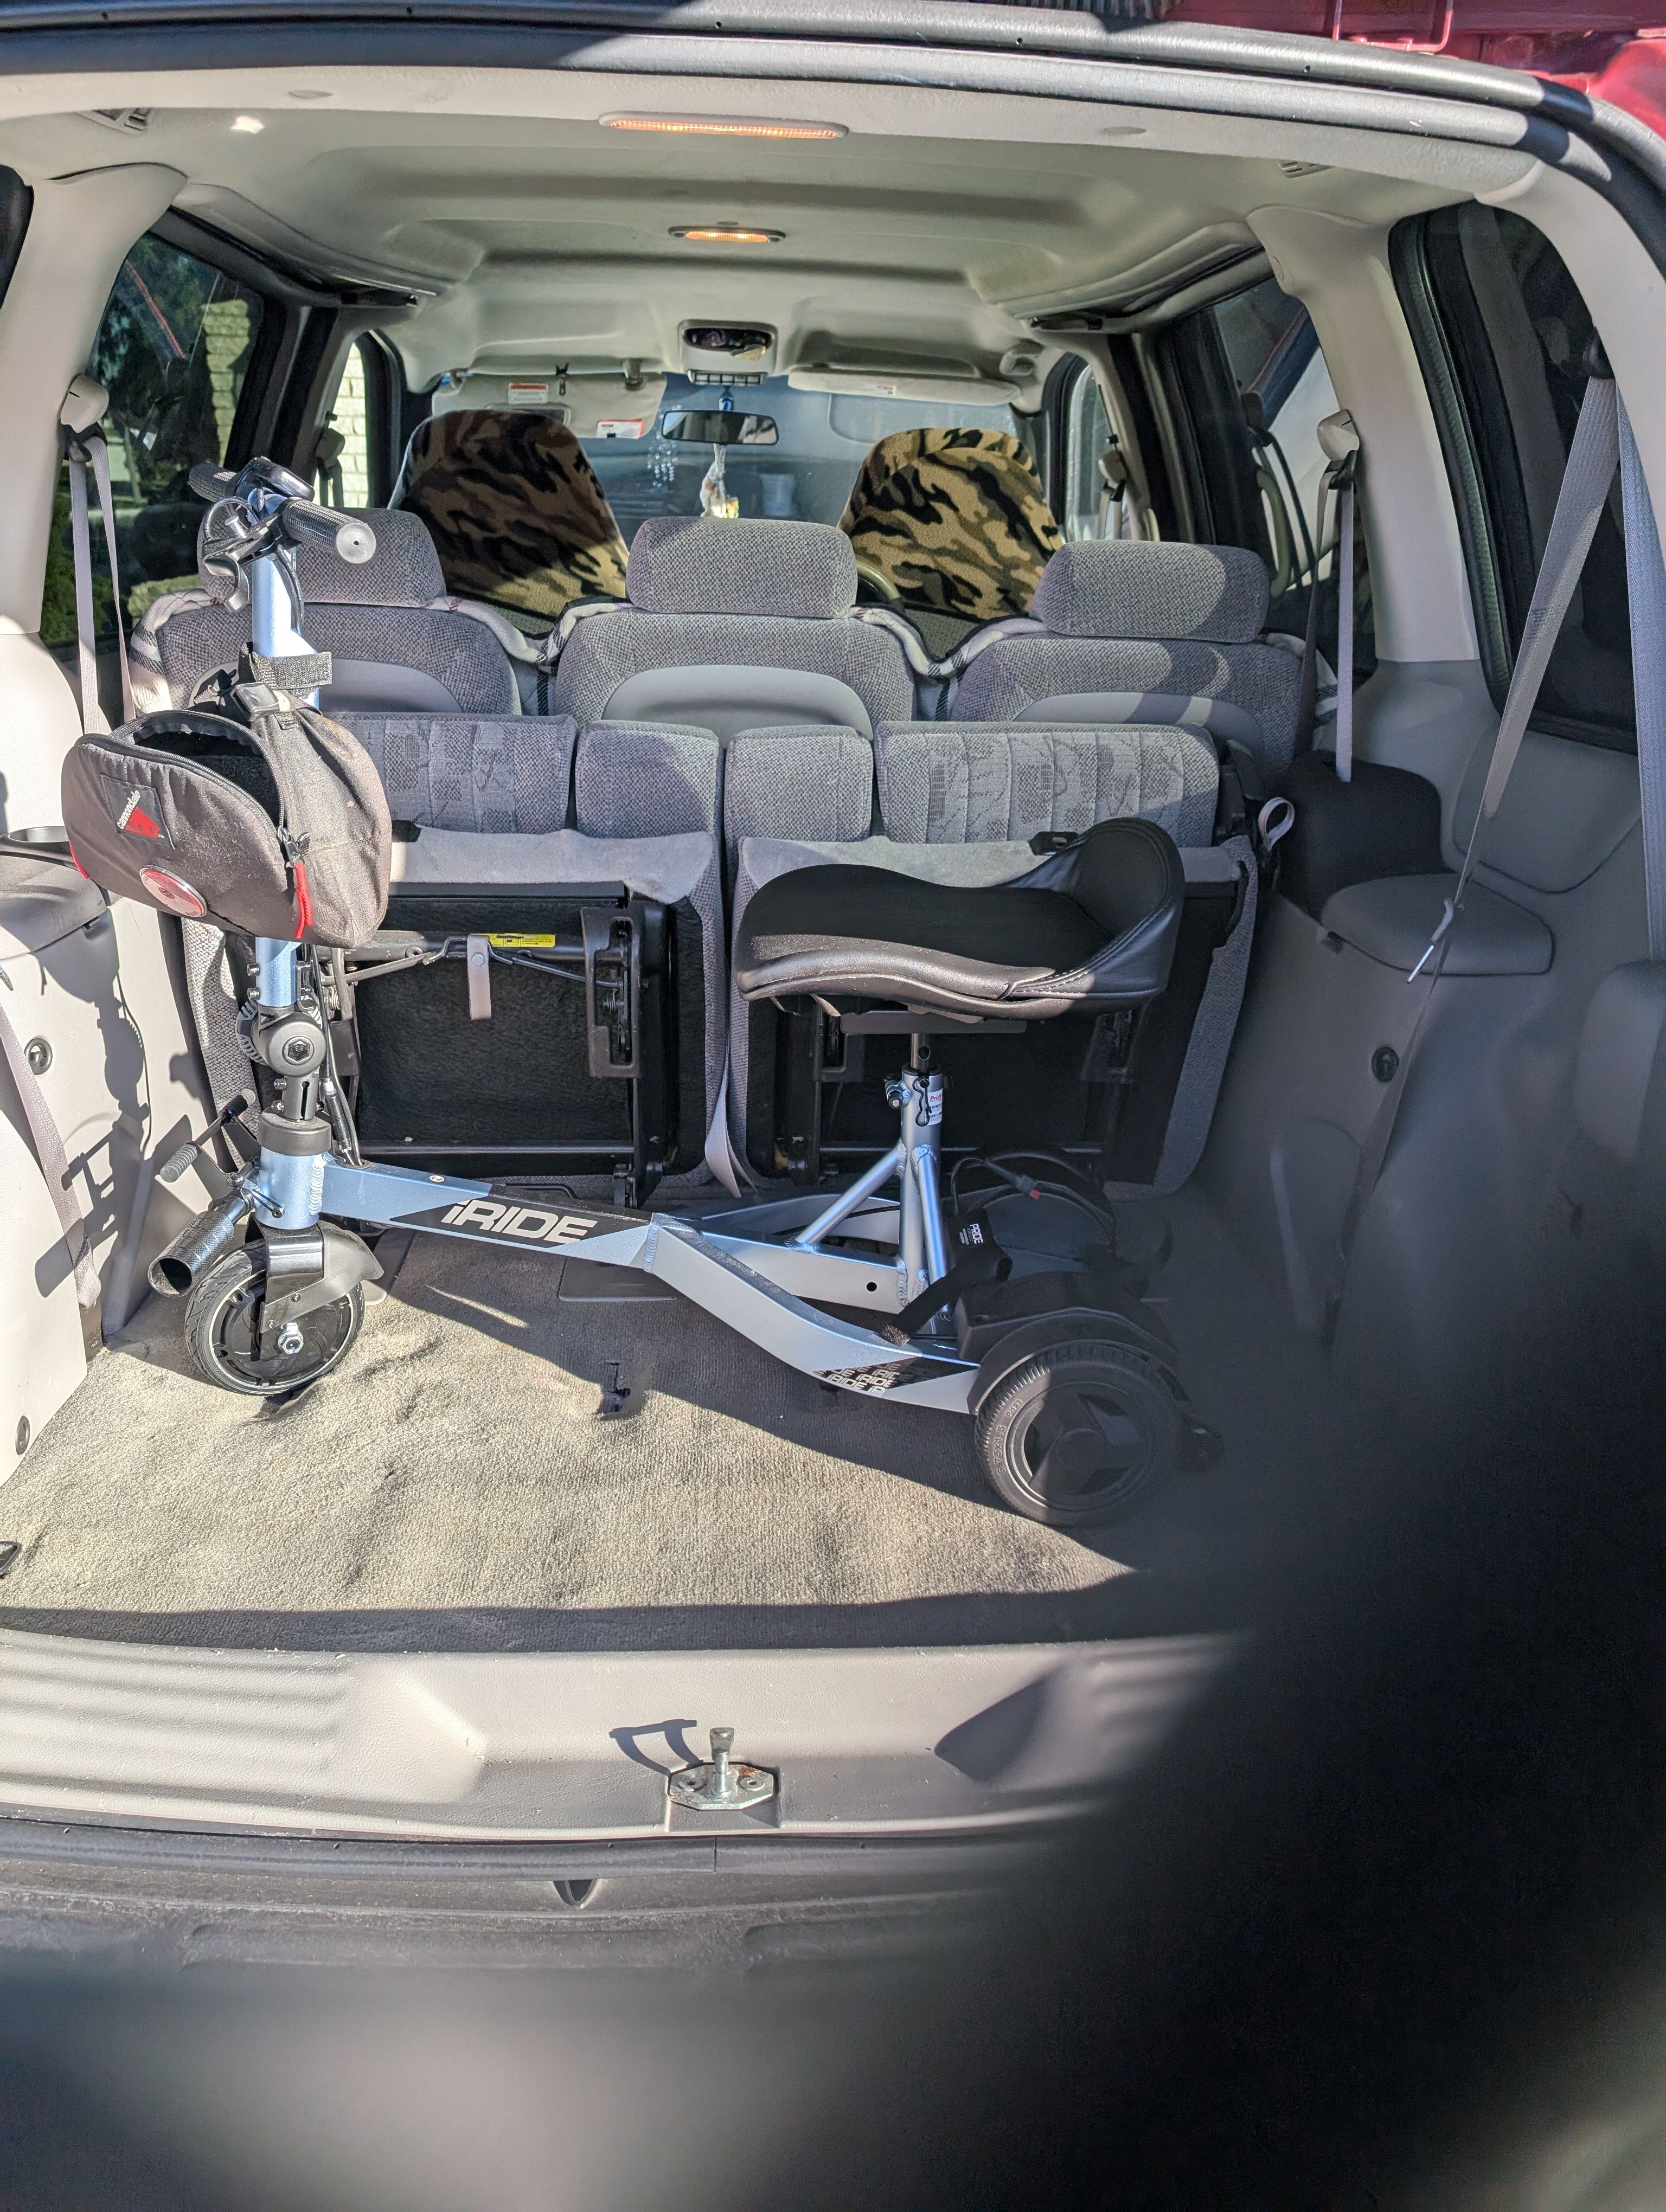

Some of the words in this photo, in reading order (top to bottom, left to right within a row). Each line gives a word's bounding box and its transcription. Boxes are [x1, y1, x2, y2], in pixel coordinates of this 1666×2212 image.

[117, 790, 141, 829] cannondale
[441, 1199, 598, 1244] iRIDE
[970, 1223, 984, 1244] PRIDE
